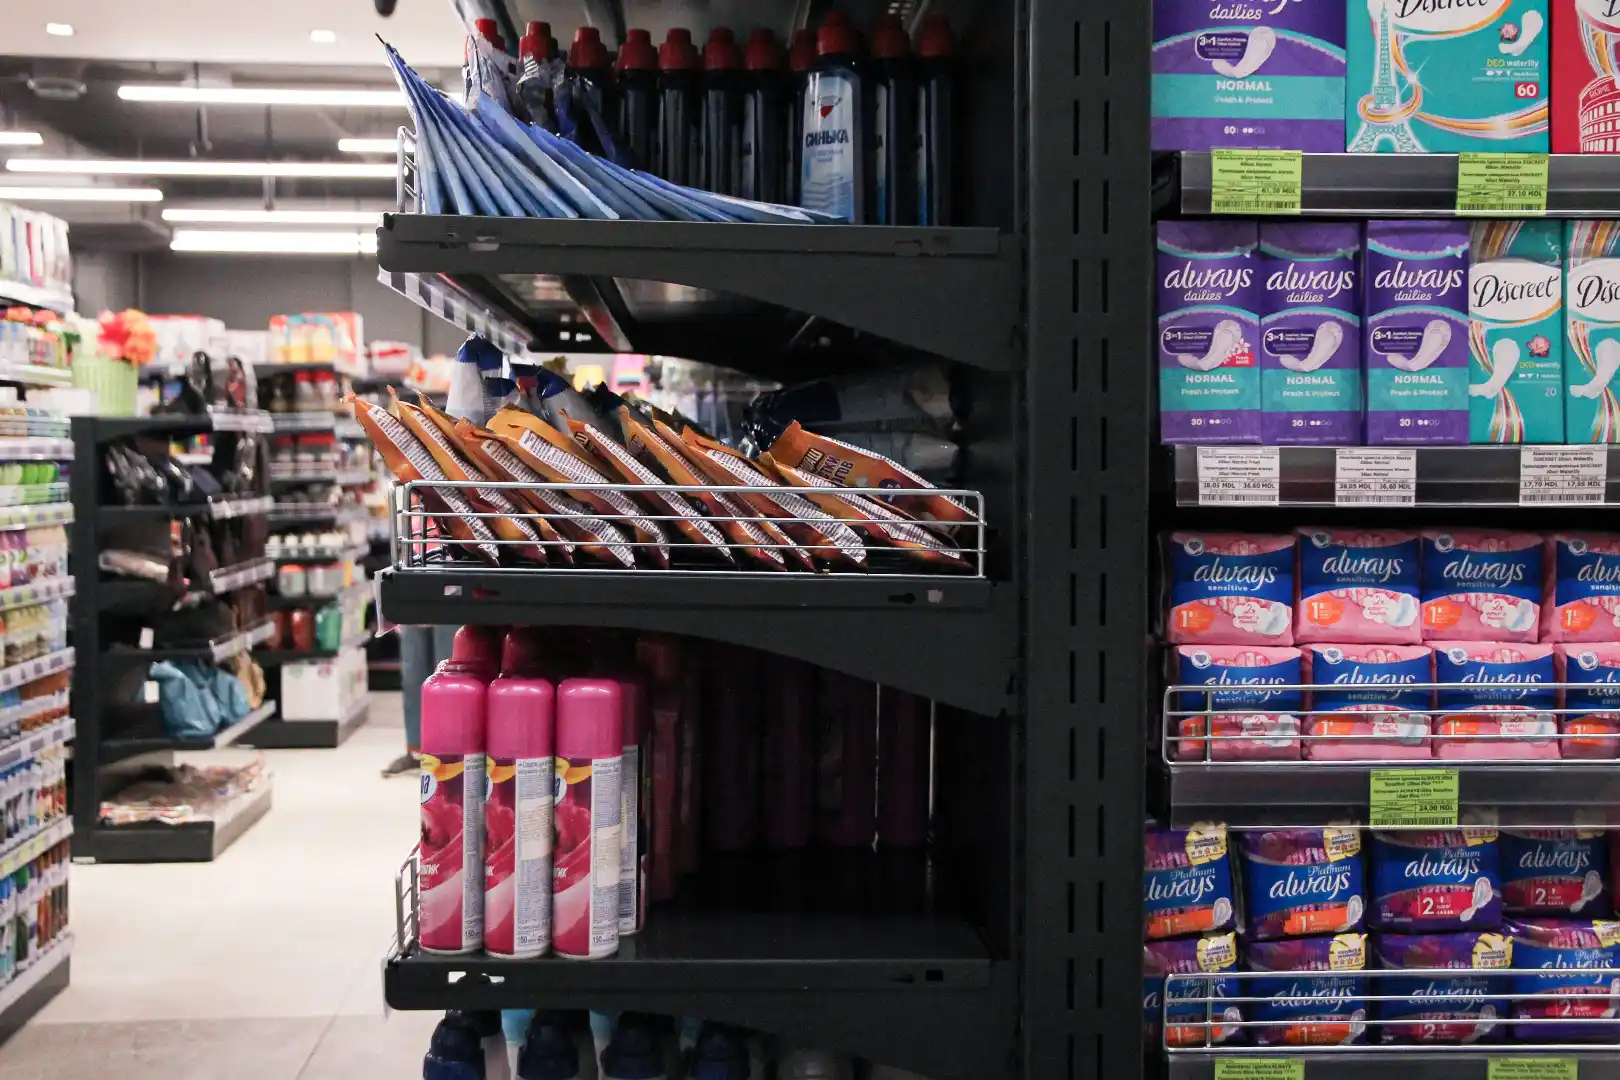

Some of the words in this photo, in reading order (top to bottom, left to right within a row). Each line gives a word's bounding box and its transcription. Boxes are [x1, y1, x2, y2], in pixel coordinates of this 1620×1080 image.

[1209, 4, 1263, 20] dailies
[1216, 80, 1273, 91] NORMAL
[1517, 84, 1537, 97] 60
[1590, 84, 1610, 98] ROME
[805, 129, 849, 147] СИНЬКА
[1164, 261, 1253, 297] always
[1266, 263, 1355, 299] always
[1374, 261, 1464, 296] always
[1184, 290, 1222, 301] dailies
[1287, 292, 1323, 303] dailies
[1394, 290, 1432, 301] dailies
[1473, 275, 1559, 308] Discreet
[1186, 375, 1235, 383] NORMAL
[1287, 377, 1335, 385] NORMAL
[1394, 376, 1444, 384] NORMAL
[1194, 557, 1278, 591] always
[1322, 550, 1403, 582] always
[1443, 554, 1526, 588] always
[1201, 670, 1285, 703] always
[1333, 666, 1416, 700] always
[1460, 666, 1541, 699] always
[1444, 849, 1480, 857] Platinum
[1520, 845, 1590, 874] always
[1171, 868, 1215, 881] Platinum
[1308, 865, 1350, 877] Platinum
[1404, 853, 1479, 882] always
[1269, 871, 1350, 899] always
[1422, 897, 1434, 915] 2
[1535, 888, 1546, 905] 2
[1538, 954, 1613, 984] always
[1271, 983, 1355, 1011] always
[1408, 982, 1487, 1012] always
[1560, 998, 1573, 1017] 2
